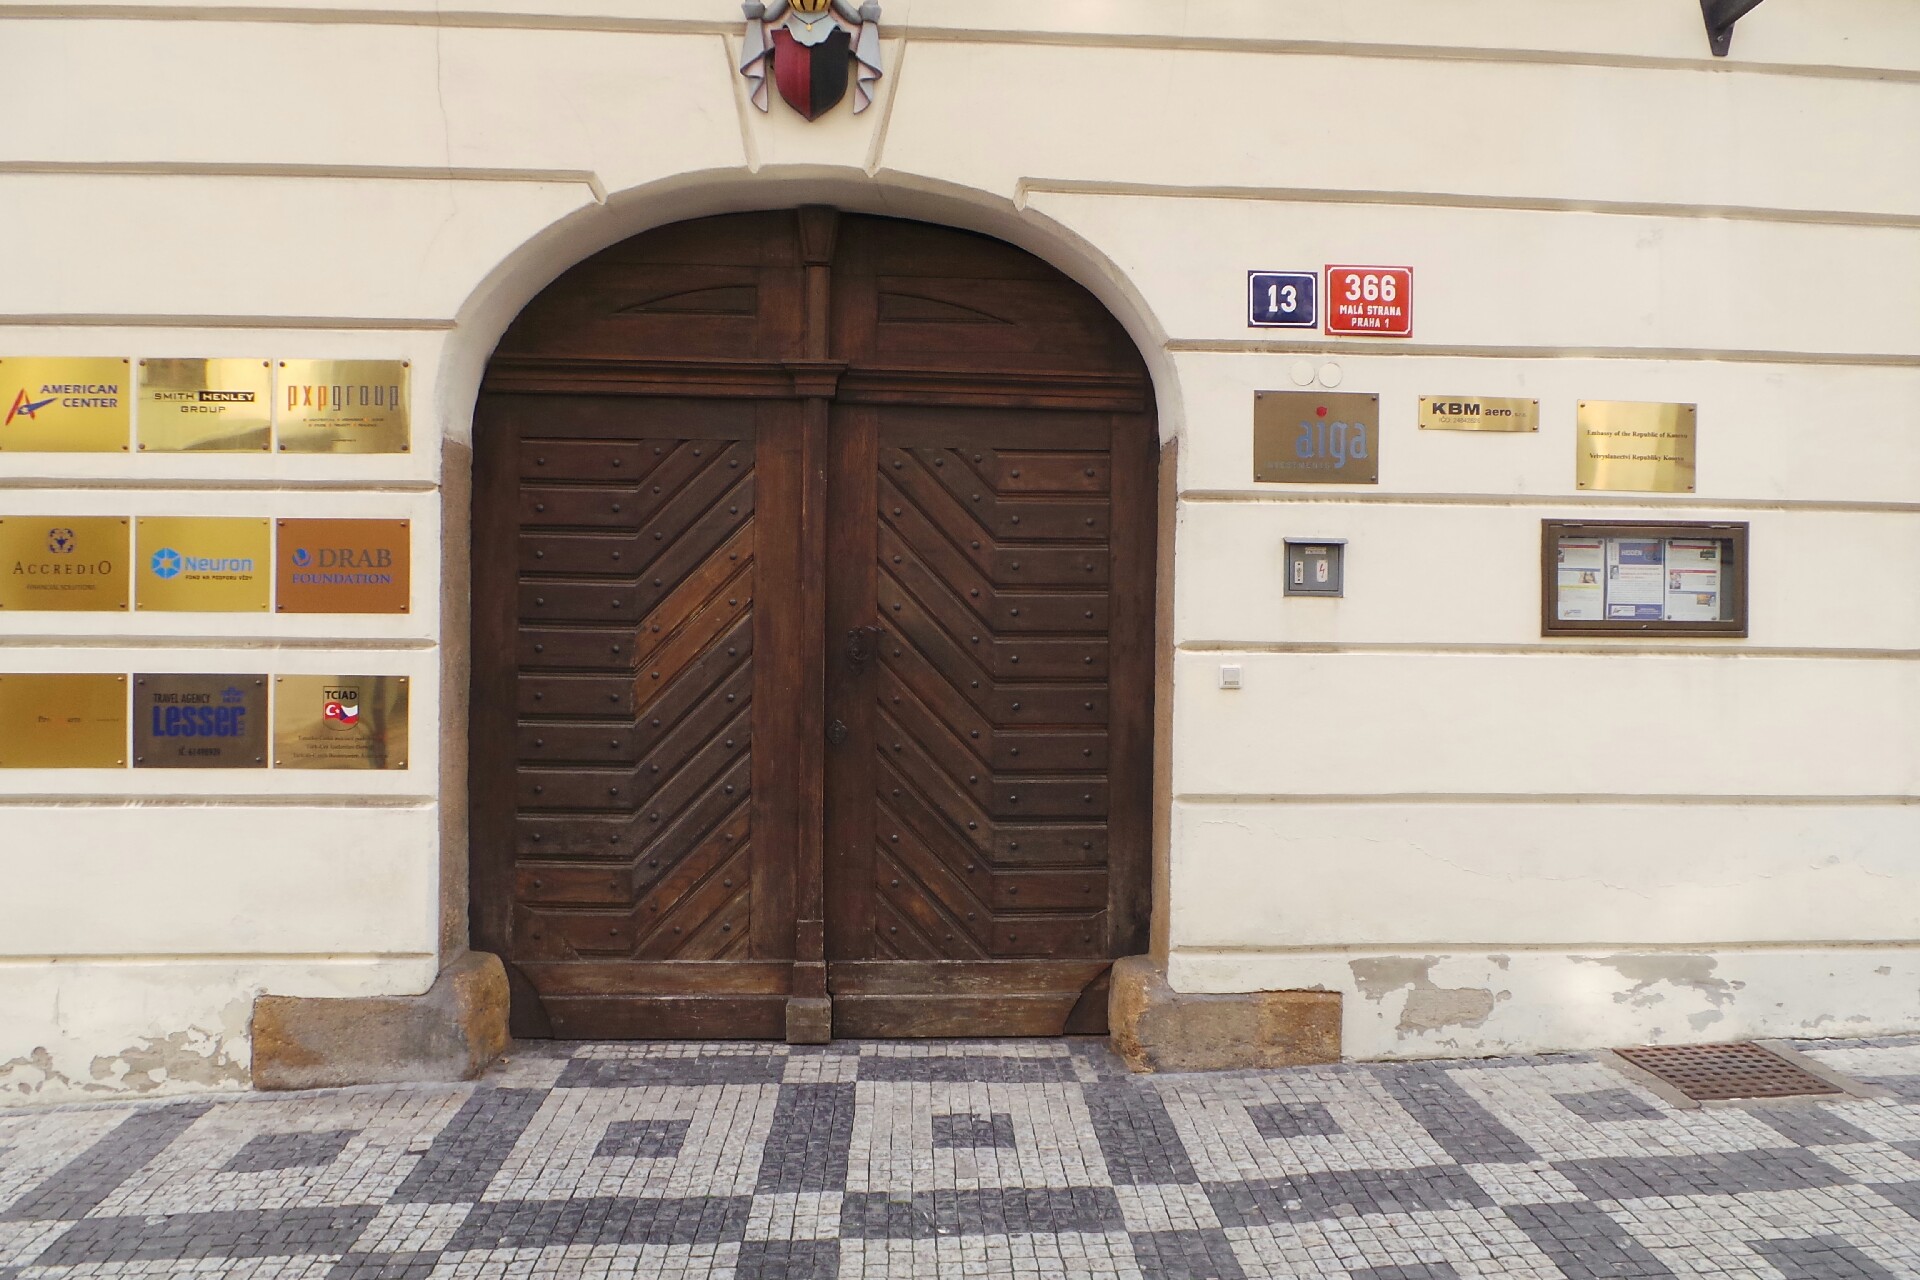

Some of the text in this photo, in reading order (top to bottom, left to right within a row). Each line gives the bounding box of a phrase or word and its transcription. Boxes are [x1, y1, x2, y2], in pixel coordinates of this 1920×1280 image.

[1345, 274, 1396, 301] 366
[1268, 284, 1297, 313] 13
[1339, 302, 1401, 316] MALÁ STRANA
[1351, 317, 1390, 328] PRAHA 1
[40, 384, 118, 394] AMERICAN
[154, 392, 254, 401] SMITH HENLEY
[62, 398, 118, 408] CENTER
[1432, 402, 1480, 415] KBM
[180, 405, 226, 413] GROUP
[1296, 406, 1368, 469] aiga
[1632, 431, 1658, 439] Republic
[185, 556, 253, 571] Neuron
[318, 548, 392, 568] DRAB
[292, 573, 393, 584] FOUNDATION
[153, 693, 210, 703] TRAVEL AGENCY
[325, 690, 358, 700] TCIAD
